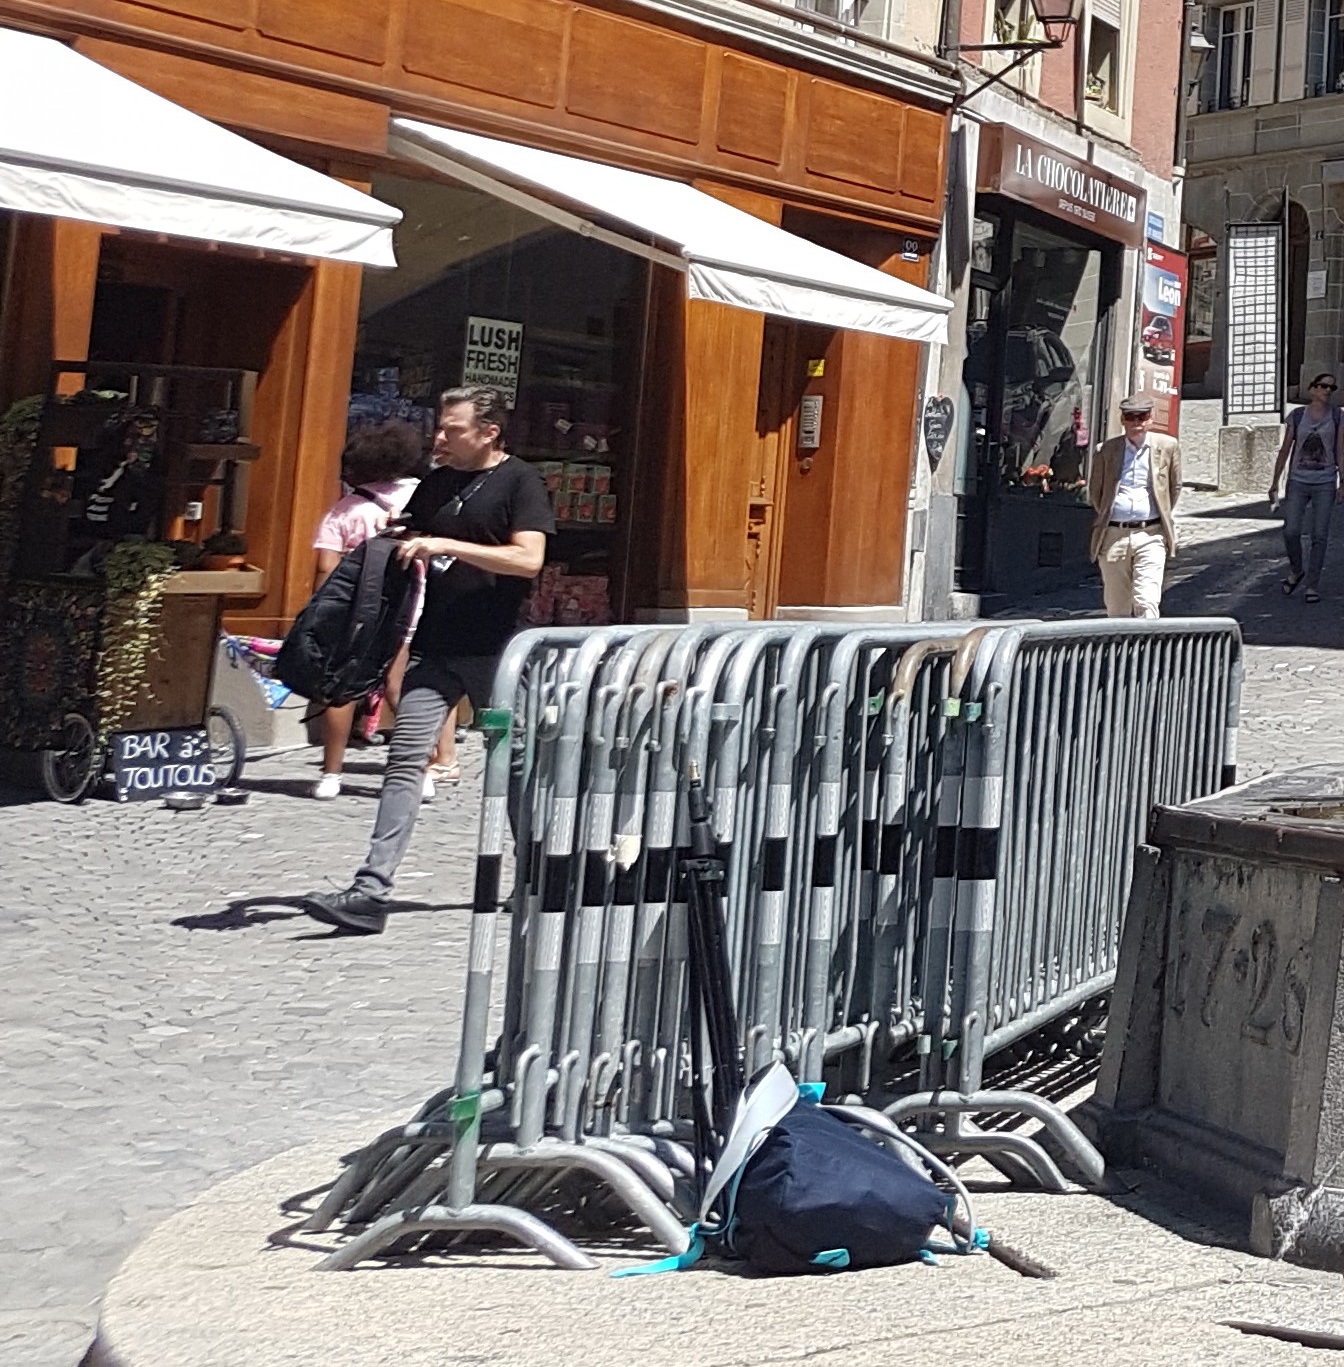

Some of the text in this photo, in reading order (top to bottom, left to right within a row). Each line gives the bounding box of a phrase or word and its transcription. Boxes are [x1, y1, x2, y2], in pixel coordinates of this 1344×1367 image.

[1016, 144, 1032, 179] LA
[469, 325, 520, 351] LUSH
[466, 350, 519, 374] FRESH
[464, 373, 517, 388] HANDMADE
[121, 732, 170, 759] BAR
[122, 764, 216, 789] TOUTOUS
